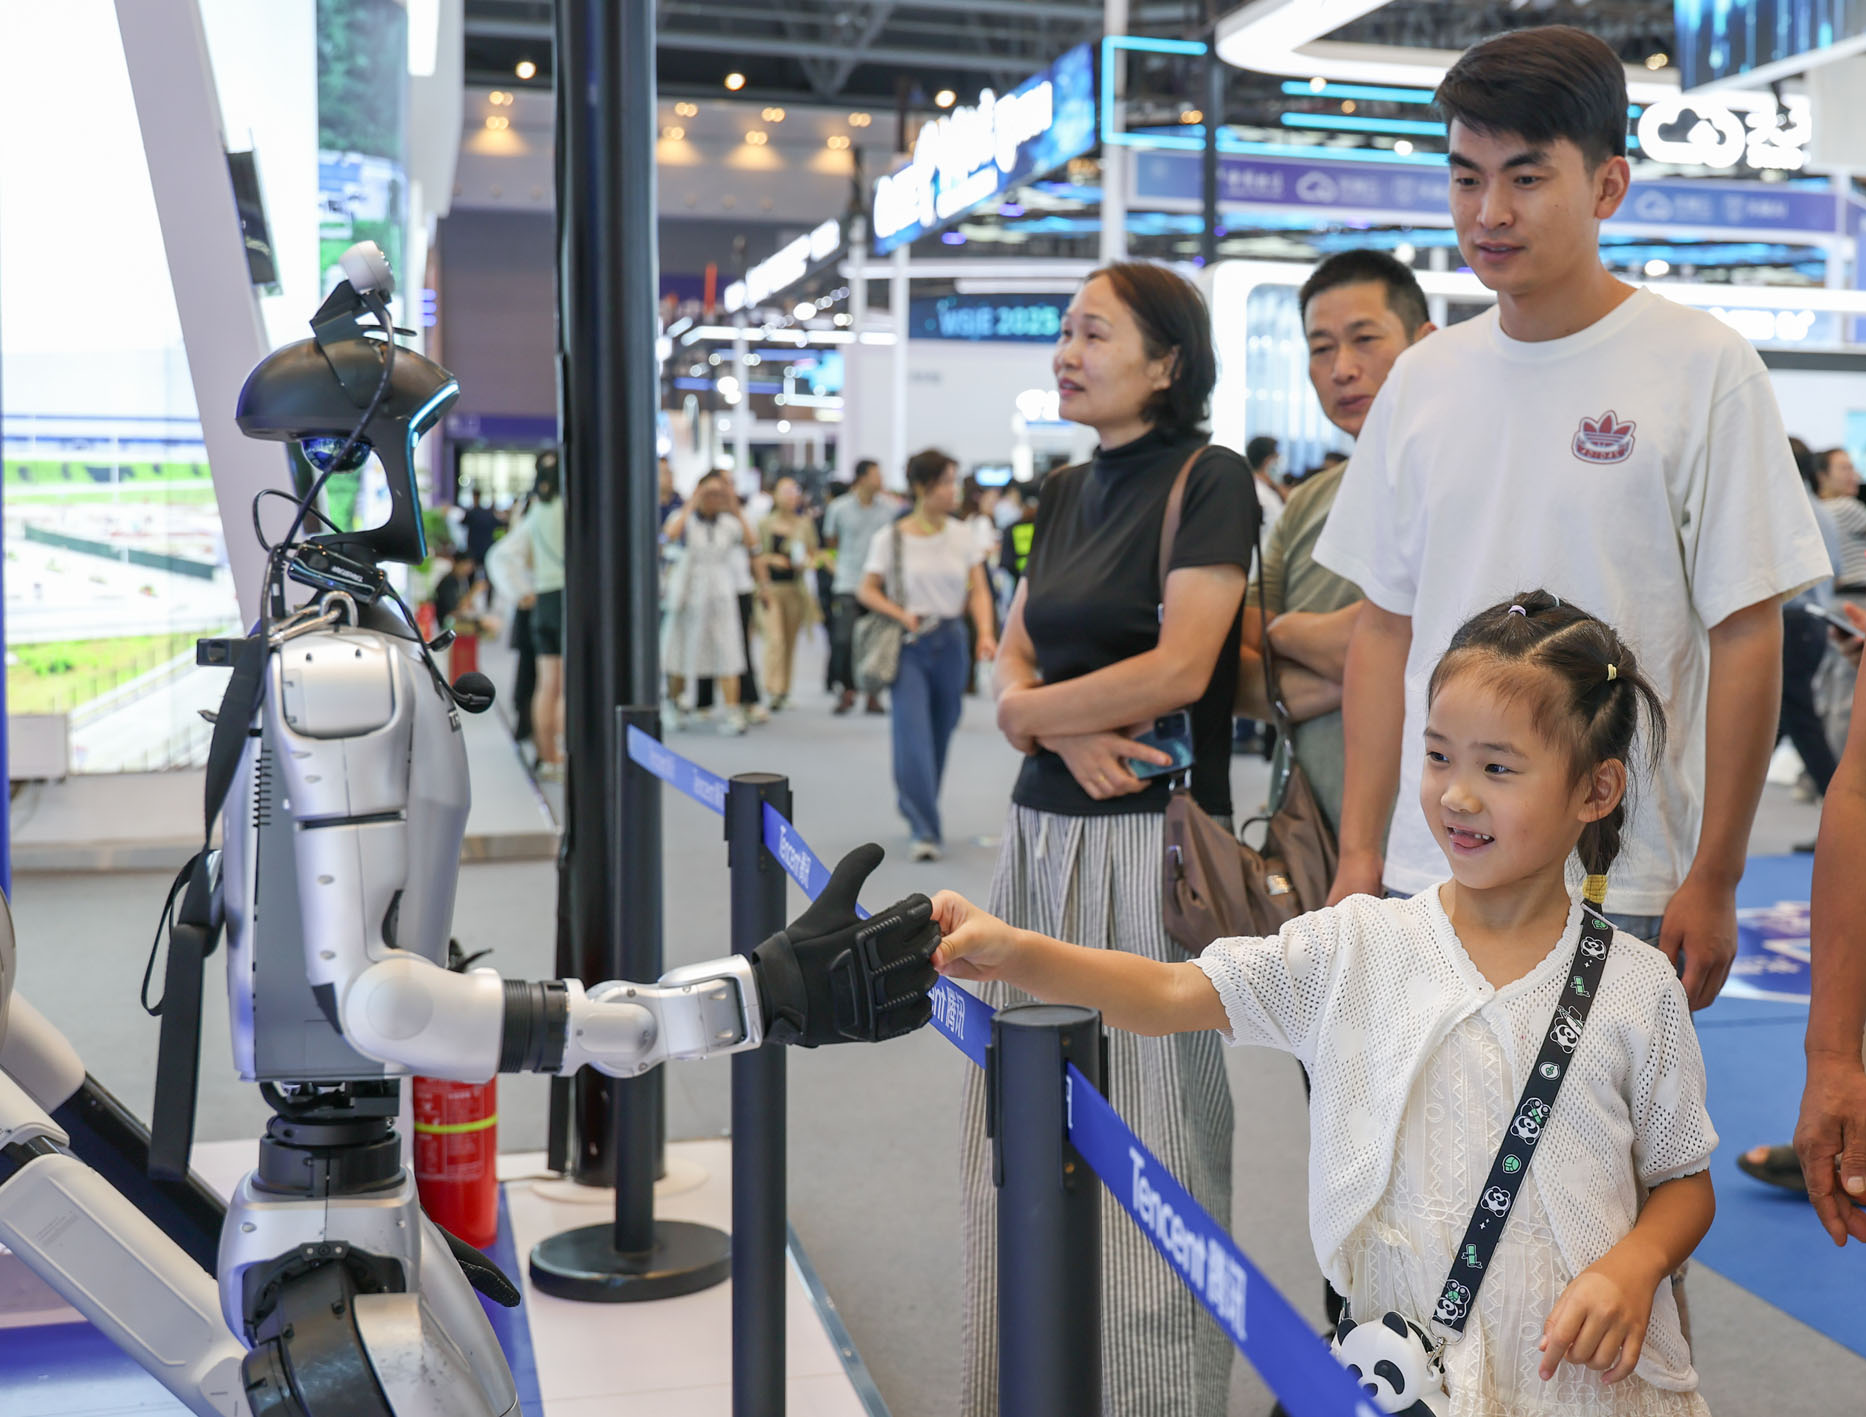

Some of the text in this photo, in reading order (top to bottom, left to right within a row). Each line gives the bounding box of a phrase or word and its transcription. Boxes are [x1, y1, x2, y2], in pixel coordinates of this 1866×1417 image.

[995, 306, 1060, 336] 2025
[945, 986, 965, 1041] 腾讯
[1128, 1146, 1206, 1291] Tencent
